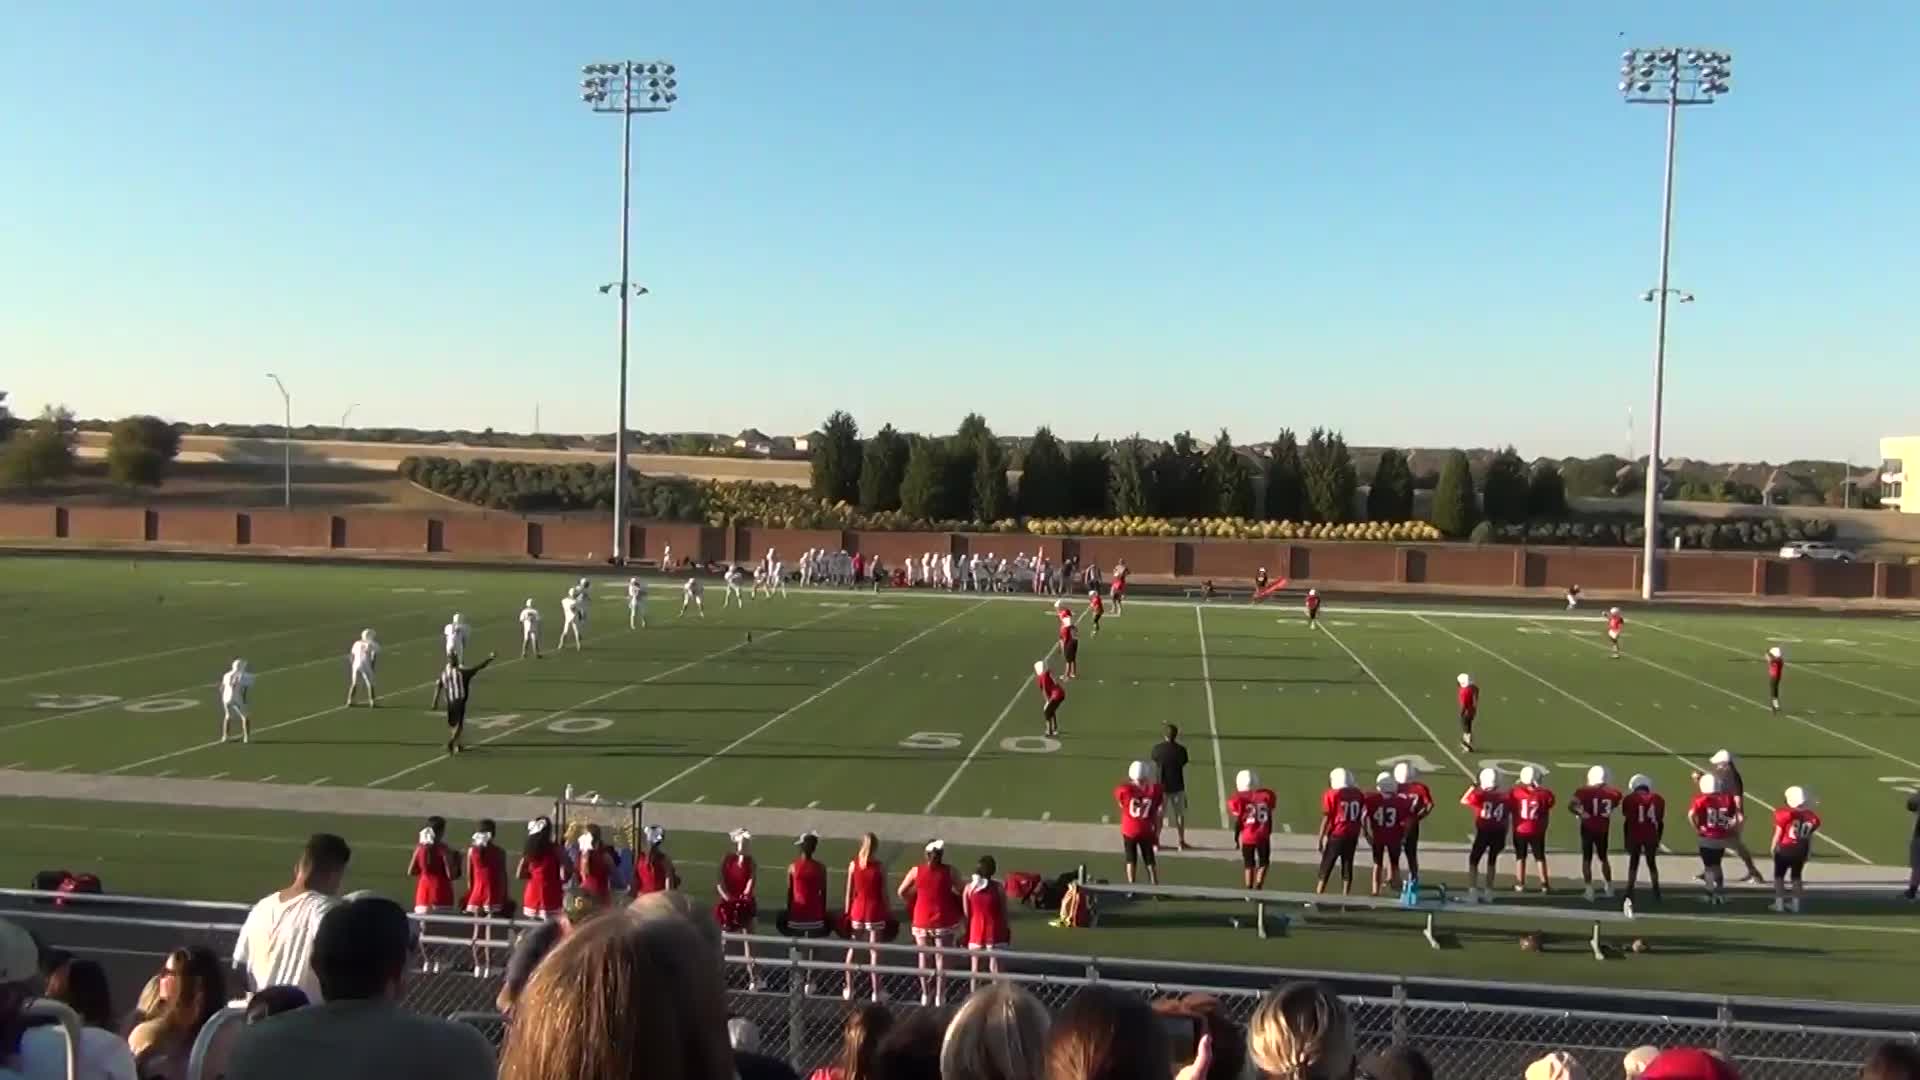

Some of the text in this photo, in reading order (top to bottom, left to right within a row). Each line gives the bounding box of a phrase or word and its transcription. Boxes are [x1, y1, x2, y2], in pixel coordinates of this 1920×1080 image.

[1129, 798, 1152, 818] 67
[1340, 801, 1359, 822] 70
[1374, 806, 1397, 828] 43
[1593, 798, 1612, 817] 13
